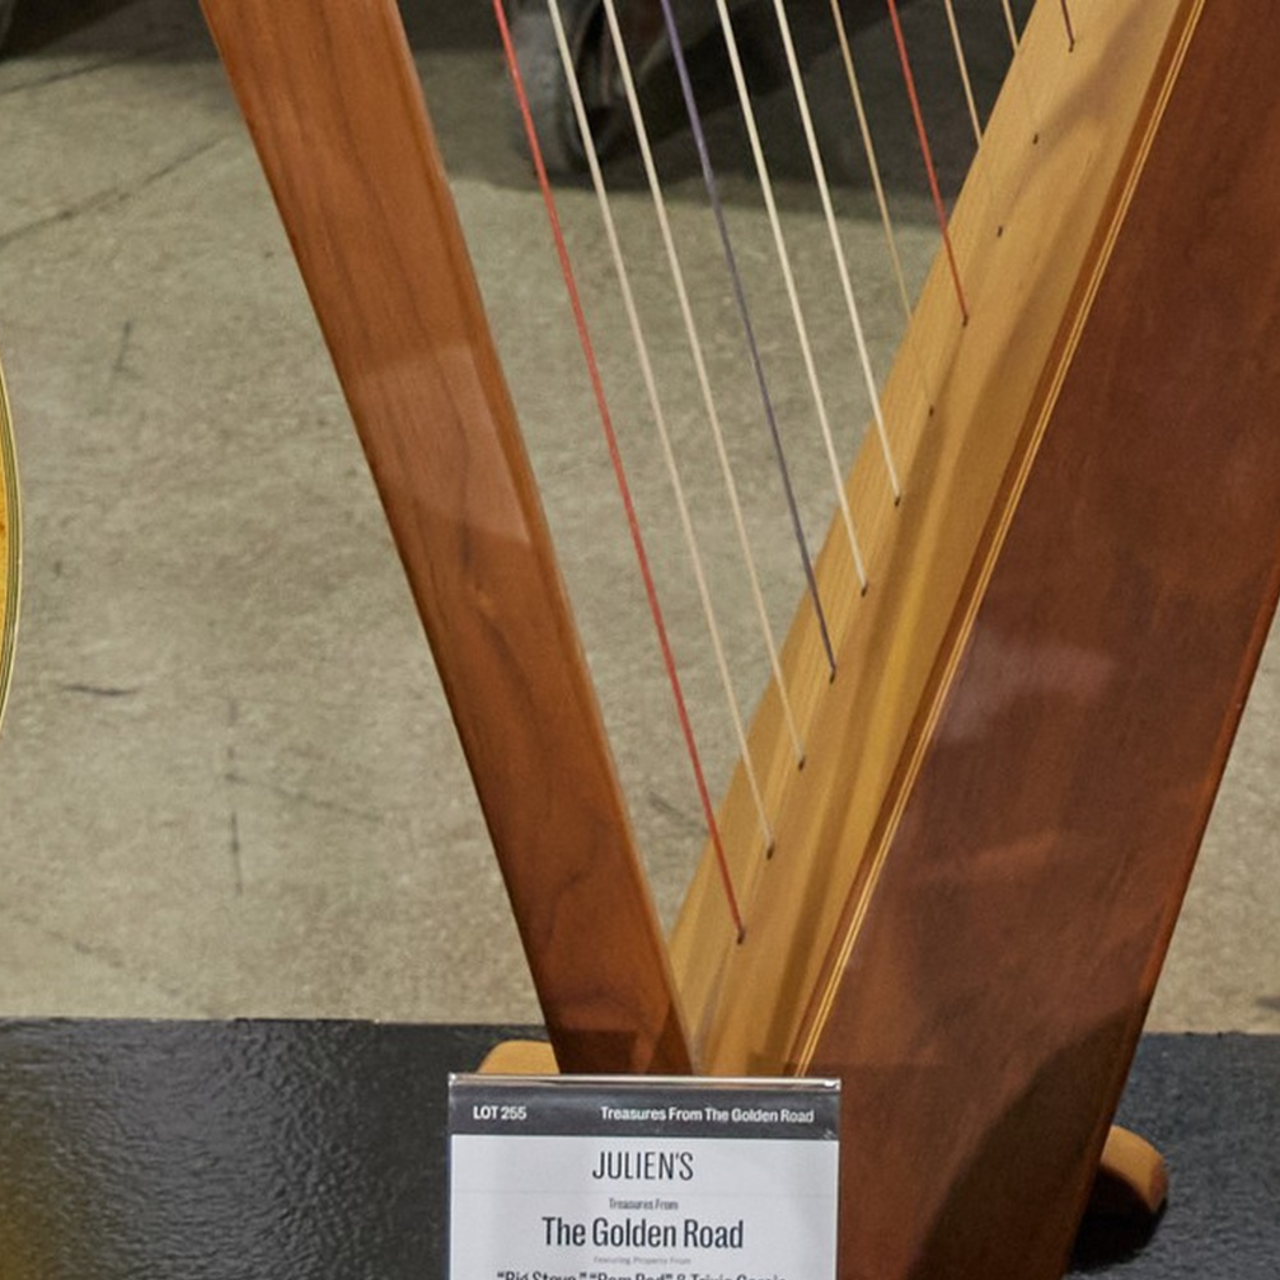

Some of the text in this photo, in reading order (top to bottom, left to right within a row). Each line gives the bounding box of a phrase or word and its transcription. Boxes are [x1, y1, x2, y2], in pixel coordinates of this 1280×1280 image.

[473, 1105, 527, 1120] LOT 255
[599, 1105, 814, 1123] Treasures From The Golden Road
[592, 1151, 694, 1181] JULIEN'S
[541, 1216, 743, 1249] The Golden Road
